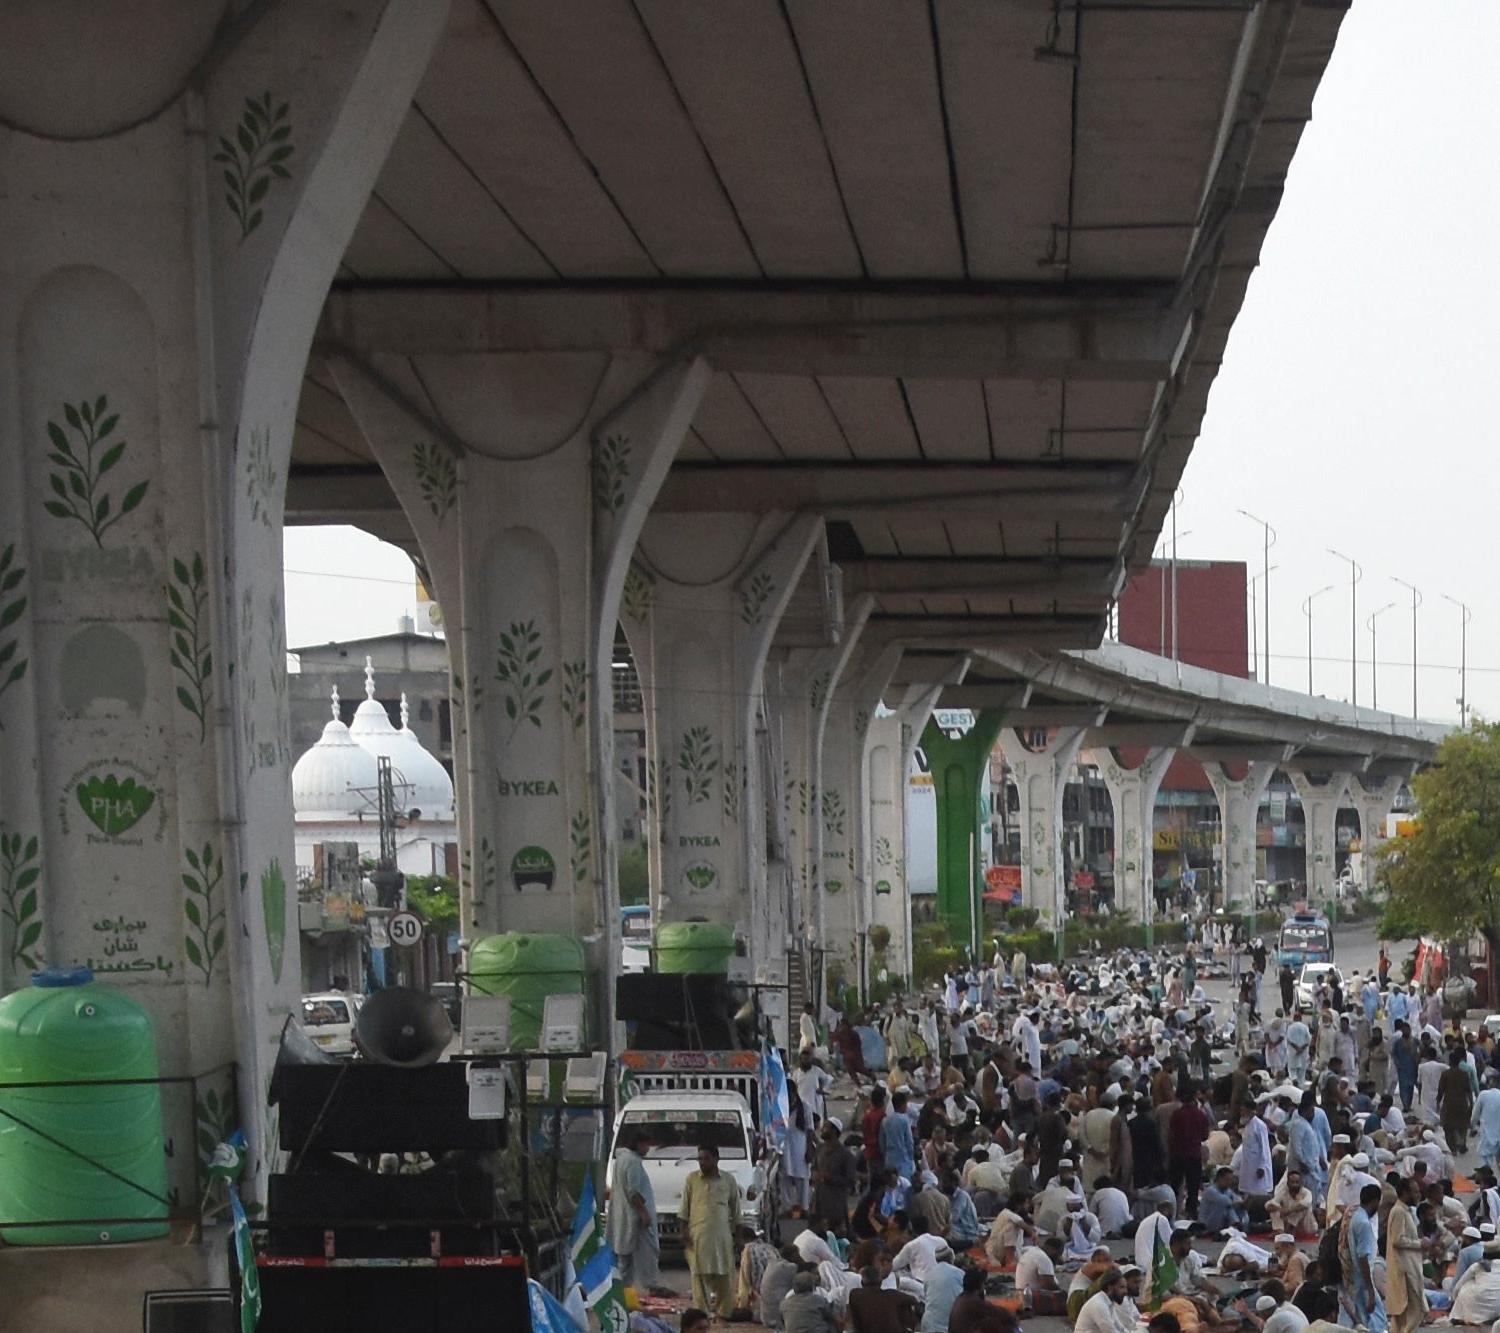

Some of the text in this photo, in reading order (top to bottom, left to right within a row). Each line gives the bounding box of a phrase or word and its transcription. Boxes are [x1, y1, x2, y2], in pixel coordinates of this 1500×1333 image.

[500, 780, 559, 796] BYKEA
[91, 797, 137, 826] PHA
[679, 836, 721, 847] BYKEA
[392, 920, 417, 940] 50
[104, 934, 138, 956] شان
[86, 955, 173, 977] پاکستا
